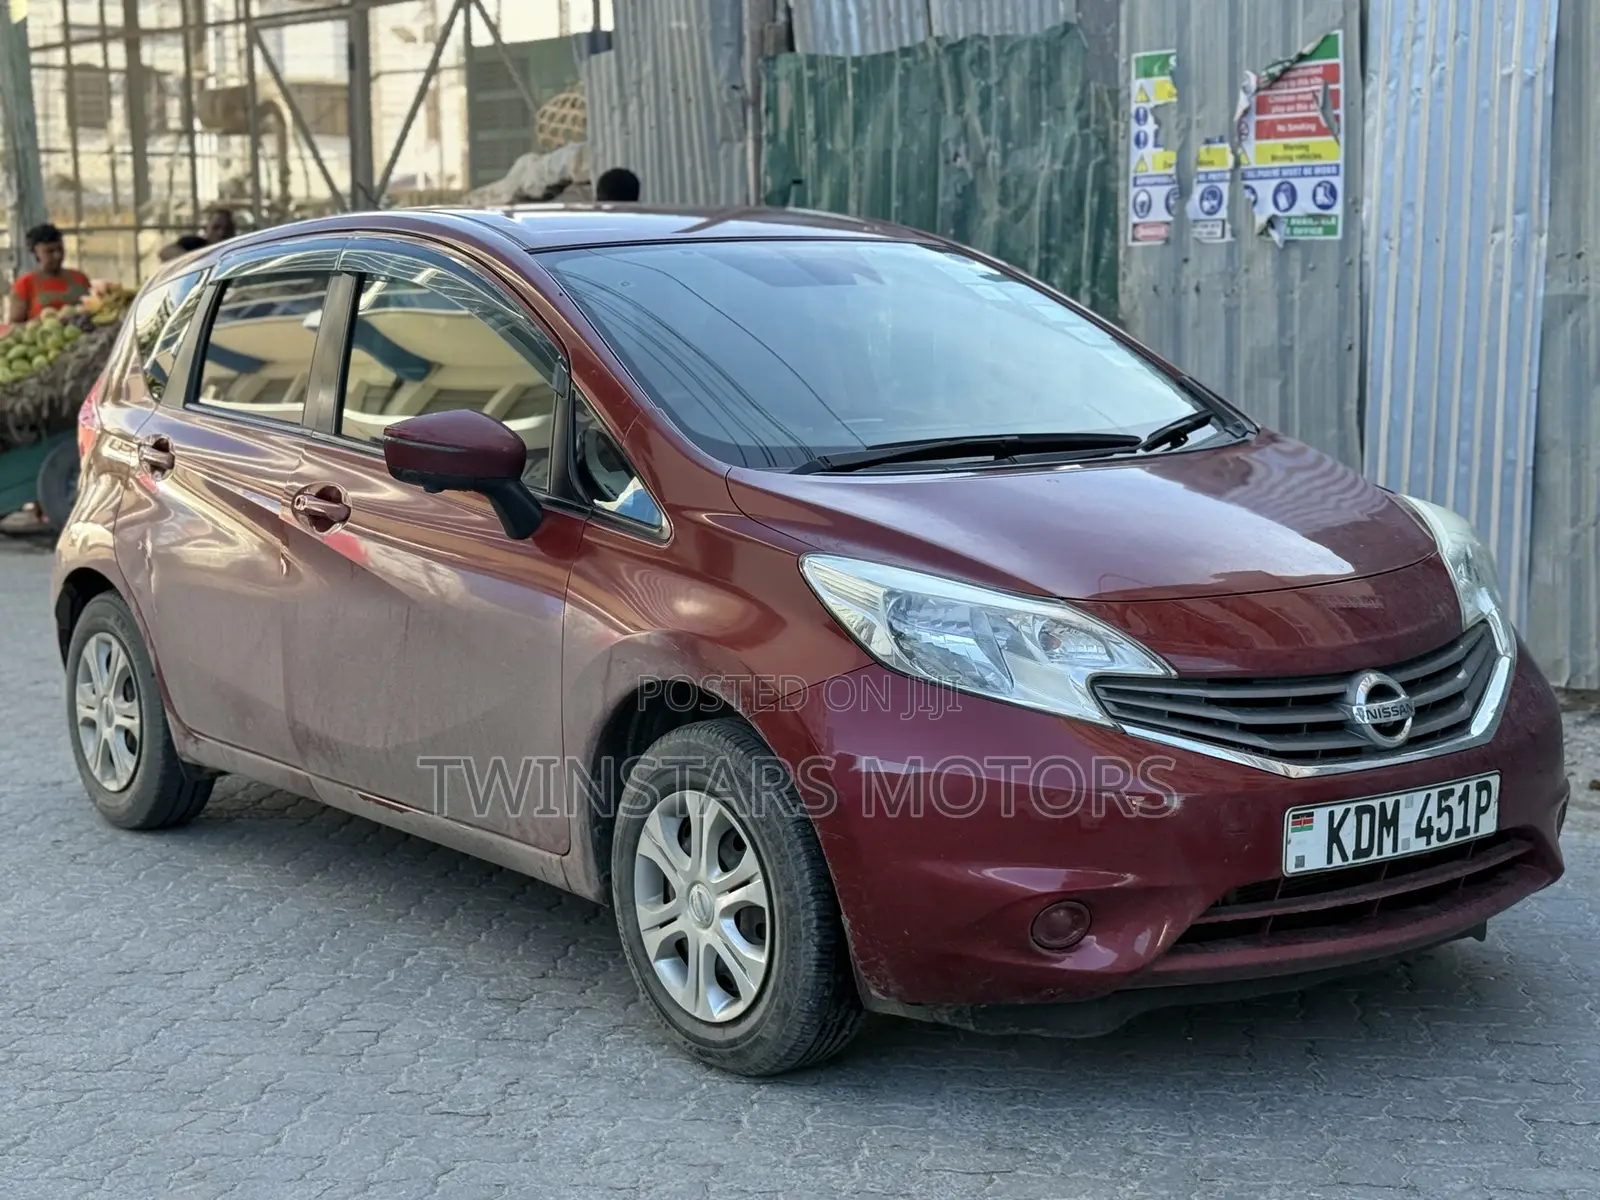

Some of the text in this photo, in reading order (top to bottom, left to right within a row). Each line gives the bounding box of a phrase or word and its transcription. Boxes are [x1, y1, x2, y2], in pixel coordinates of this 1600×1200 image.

[1276, 122, 1317, 132] No Smoking
[1365, 702, 1414, 720] NISSAN
[1326, 798, 1401, 865] KDM
[1415, 779, 1493, 847] 451P
